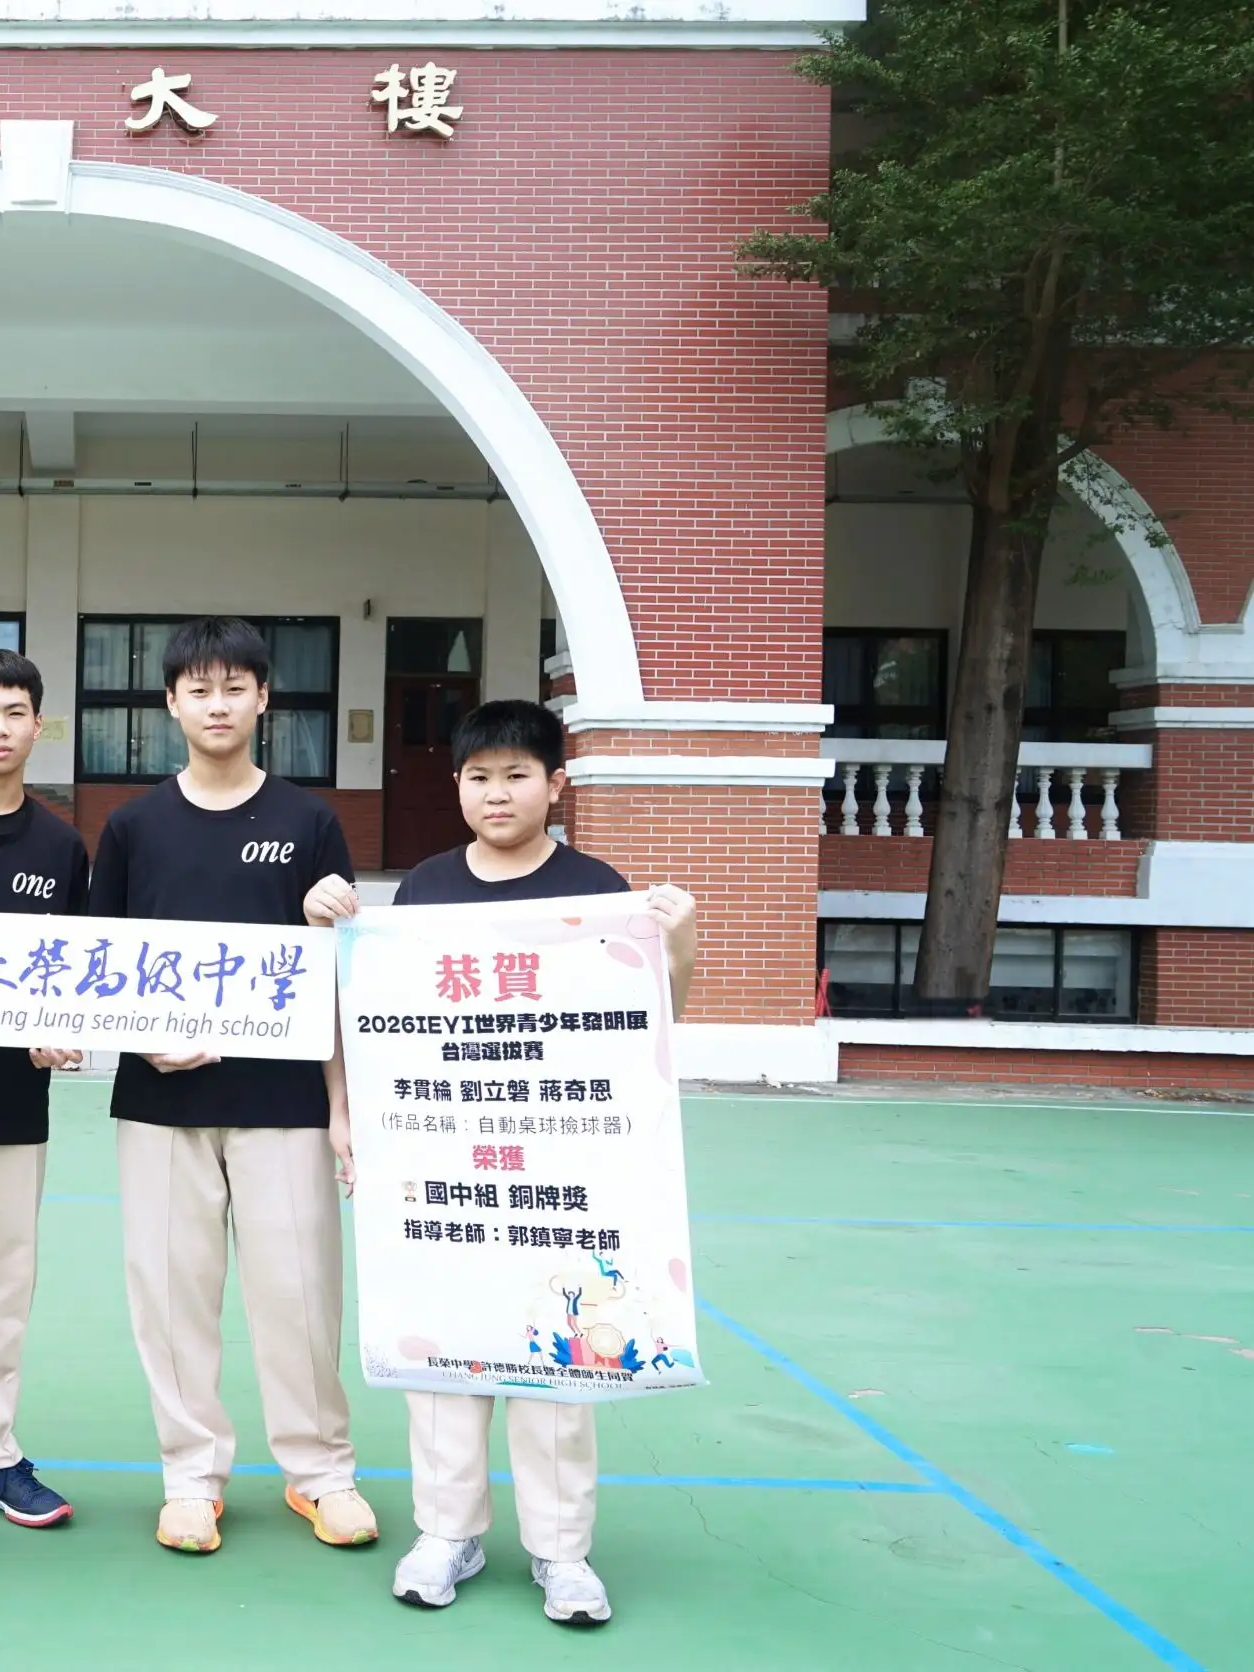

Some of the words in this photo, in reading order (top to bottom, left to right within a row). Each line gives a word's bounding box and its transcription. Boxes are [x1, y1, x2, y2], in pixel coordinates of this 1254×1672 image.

[240, 840, 295, 864] one
[12, 872, 56, 899] one
[436, 952, 543, 1003] 恭賀
[33, 1007, 85, 1034] Jung
[91, 1012, 160, 1032] senior
[165, 1011, 213, 1040] high
[219, 1014, 292, 1038] school
[357, 1010, 649, 1035] 2026IEYI世界青少年發明展
[441, 1040, 544, 1062] 台灣選拔賽
[538, 1078, 613, 1103] 蔣奇恩
[472, 1145, 525, 1171] 榮獲
[424, 1180, 500, 1208] 國中組
[508, 1184, 588, 1212] 銅牌獎
